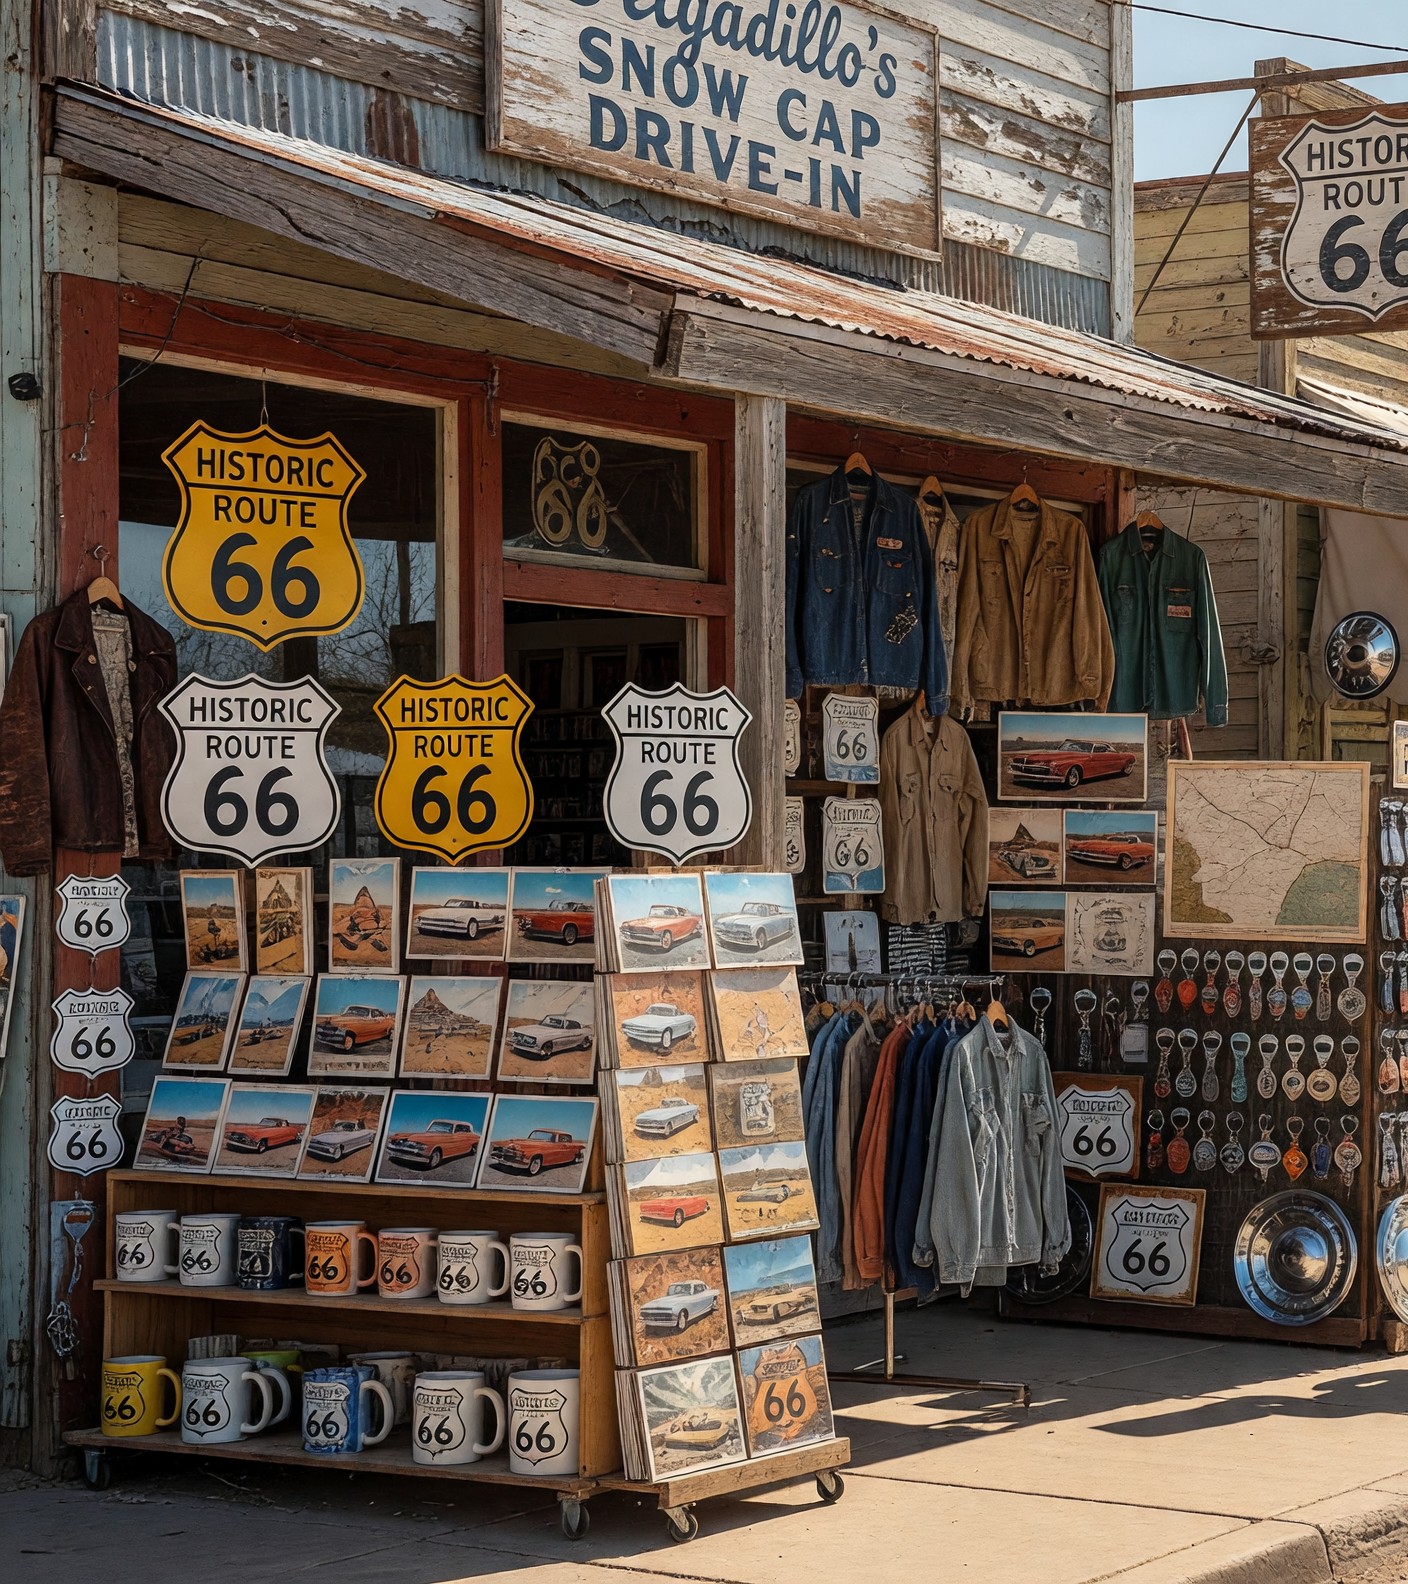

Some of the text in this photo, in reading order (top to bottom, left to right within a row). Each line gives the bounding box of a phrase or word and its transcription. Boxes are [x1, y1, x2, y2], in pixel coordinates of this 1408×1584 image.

[579, 26, 880, 159] SNOW CAP
[589, 94, 862, 218] DRIVE-IN
[196, 447, 335, 488] HISTORIC
[213, 495, 317, 529] ROUTE
[211, 532, 320, 619] 66
[189, 696, 313, 723] HISTORIC
[400, 696, 509, 723] HISTORIC
[627, 704, 729, 731] HISTORIC
[206, 735, 296, 760] ROUTE
[414, 734, 494, 758] ROUTE
[641, 741, 716, 766] ROUTE
[836, 729, 867, 761] 66
[204, 765, 299, 837] 66
[411, 764, 497, 835] 66
[640, 769, 720, 837] 66
[74, 908, 113, 938] 66
[71, 1026, 116, 1060] 66
[66, 1129, 108, 1160] 66
[1073, 1124, 1117, 1157] 66
[308, 1255, 338, 1280] 66
[380, 1259, 412, 1284] 66
[1123, 1238, 1170, 1277] 66
[514, 1268, 547, 1296] 66
[104, 1395, 135, 1420] 66
[186, 1399, 220, 1426] 66
[764, 1378, 806, 1422] 66
[306, 1410, 339, 1439] 66
[418, 1415, 453, 1445] 66
[516, 1420, 555, 1453] 66
